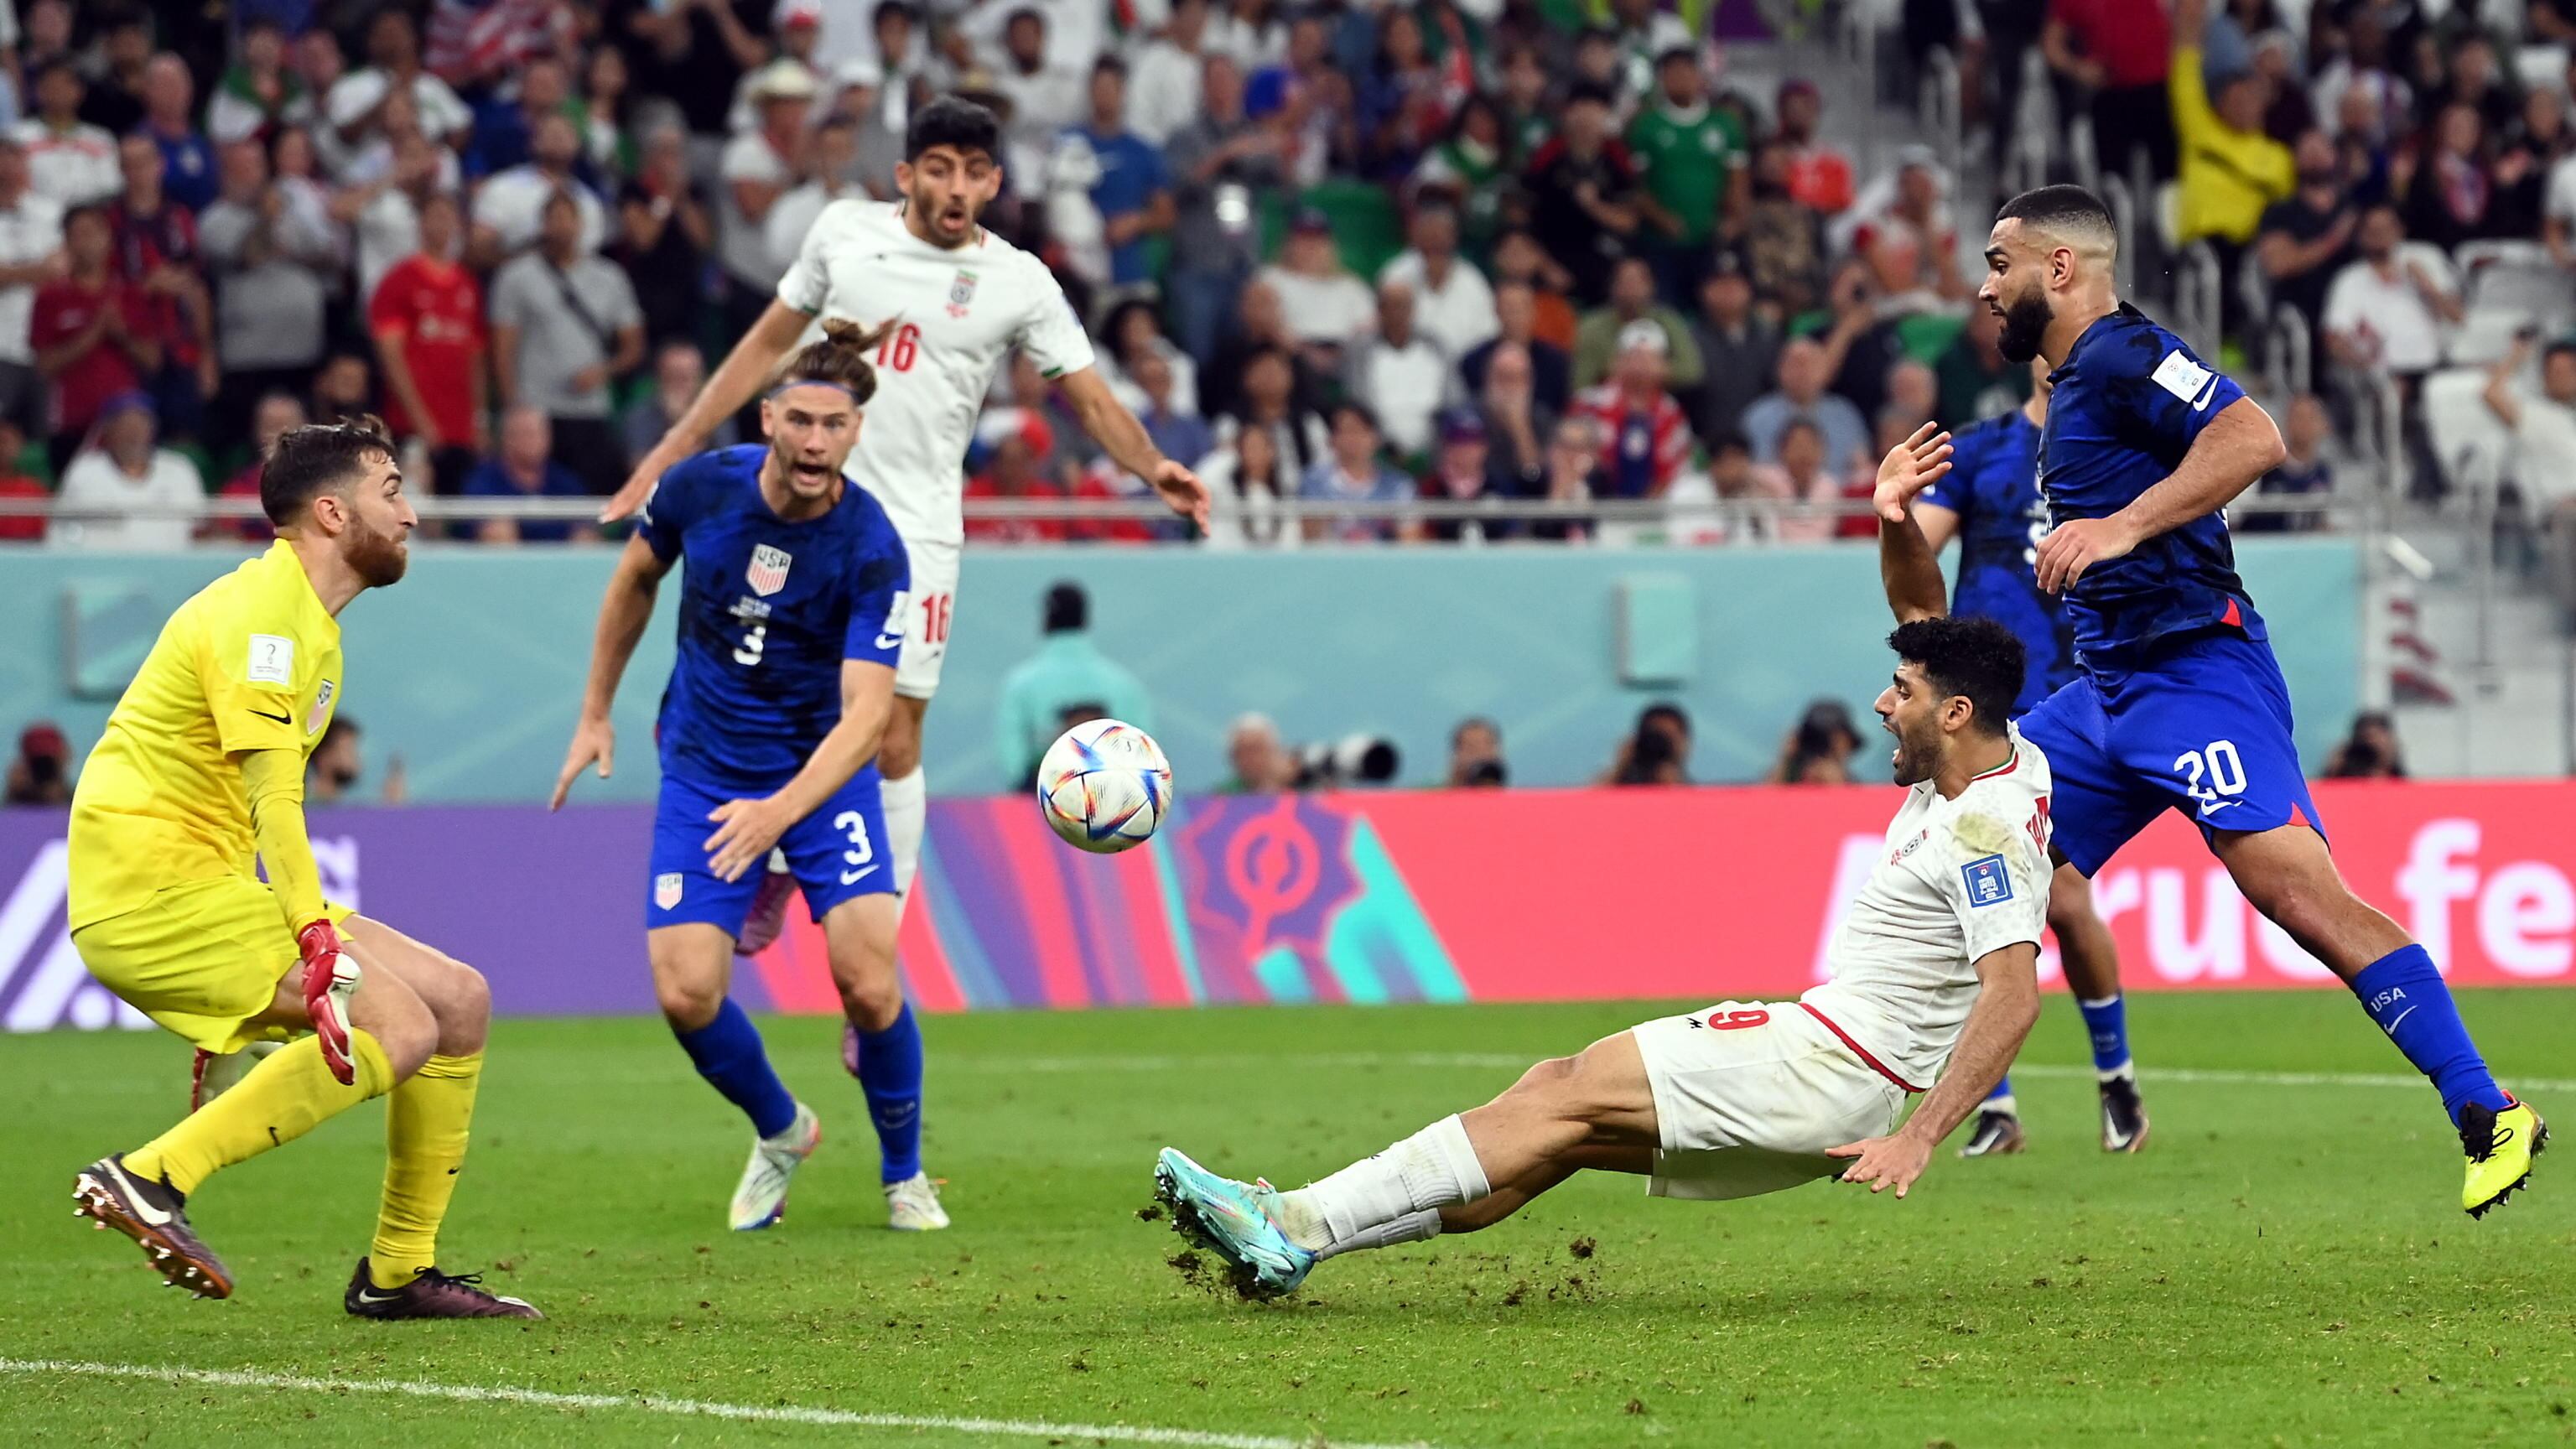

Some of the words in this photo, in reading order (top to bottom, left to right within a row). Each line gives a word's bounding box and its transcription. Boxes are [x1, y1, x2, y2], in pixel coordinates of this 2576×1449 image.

[877, 319, 921, 372] 16
[757, 548, 789, 569] USA
[921, 594, 950, 644] 16
[732, 626, 767, 666] 3
[2174, 740, 2247, 800] 20
[834, 809, 873, 865] 3
[1708, 1010, 1769, 1031] 9
[2371, 987, 2407, 1012] USA
